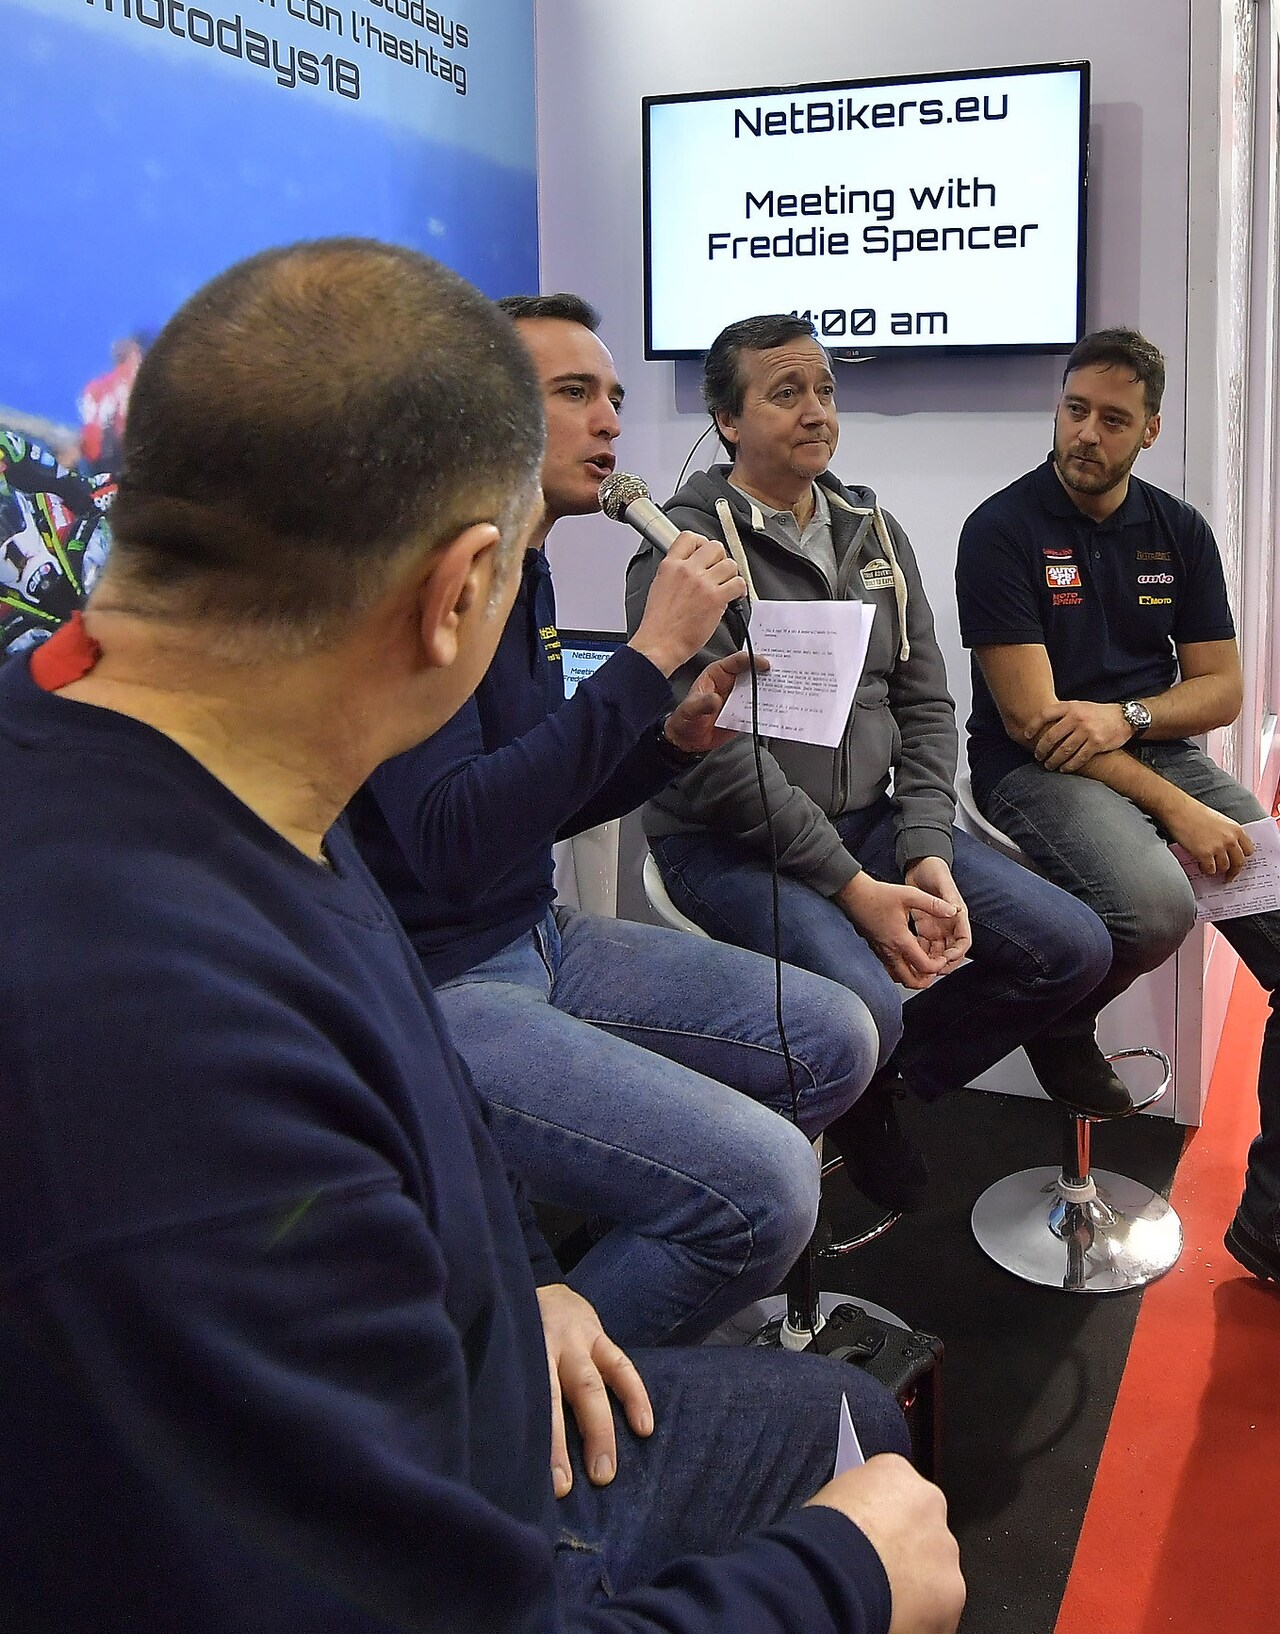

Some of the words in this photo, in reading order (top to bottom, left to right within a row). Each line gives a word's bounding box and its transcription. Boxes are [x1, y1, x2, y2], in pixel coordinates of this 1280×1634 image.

[351, 9, 468, 96] l'hashtag
[734, 93, 1009, 138] NetBikers.eu
[746, 184, 895, 221] Meeting
[909, 177, 996, 210] with
[708, 227, 849, 260] Freddie
[863, 223, 1039, 261] Spencer
[891, 311, 948, 337] am
[1048, 567, 1077, 575] AUTO
